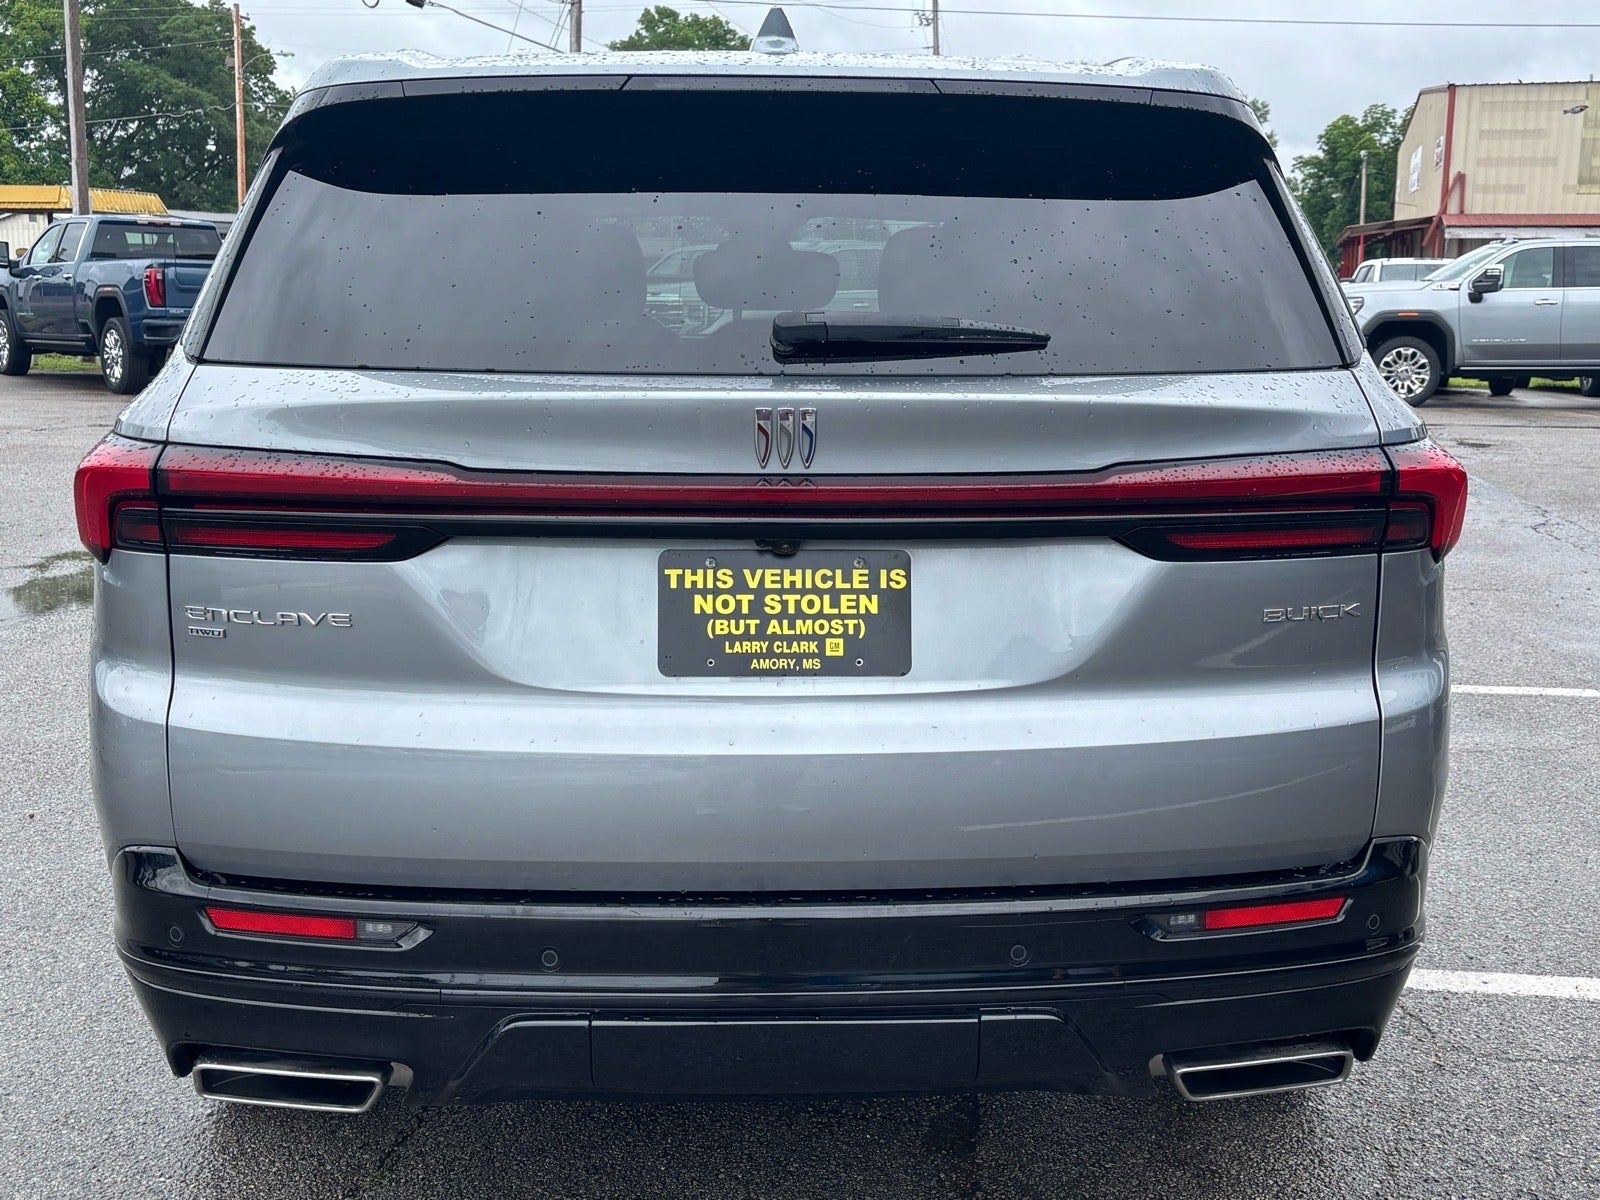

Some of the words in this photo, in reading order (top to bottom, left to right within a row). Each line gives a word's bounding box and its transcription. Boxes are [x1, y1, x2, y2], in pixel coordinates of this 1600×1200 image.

[664, 568, 734, 589] THIS
[743, 568, 870, 589] VEHICLE
[880, 568, 907, 589] IS
[693, 594, 754, 615] NOT
[764, 594, 879, 615] STOLEN
[1262, 602, 1361, 623] BUICK
[185, 605, 352, 627] ENCLAVE
[706, 619, 760, 639] (BUT
[766, 619, 866, 639] ALMOST)
[725, 641, 769, 654] LARRY
[773, 641, 818, 654] CLARK
[750, 658, 800, 671] AMORY,
[802, 658, 821, 670] MS
